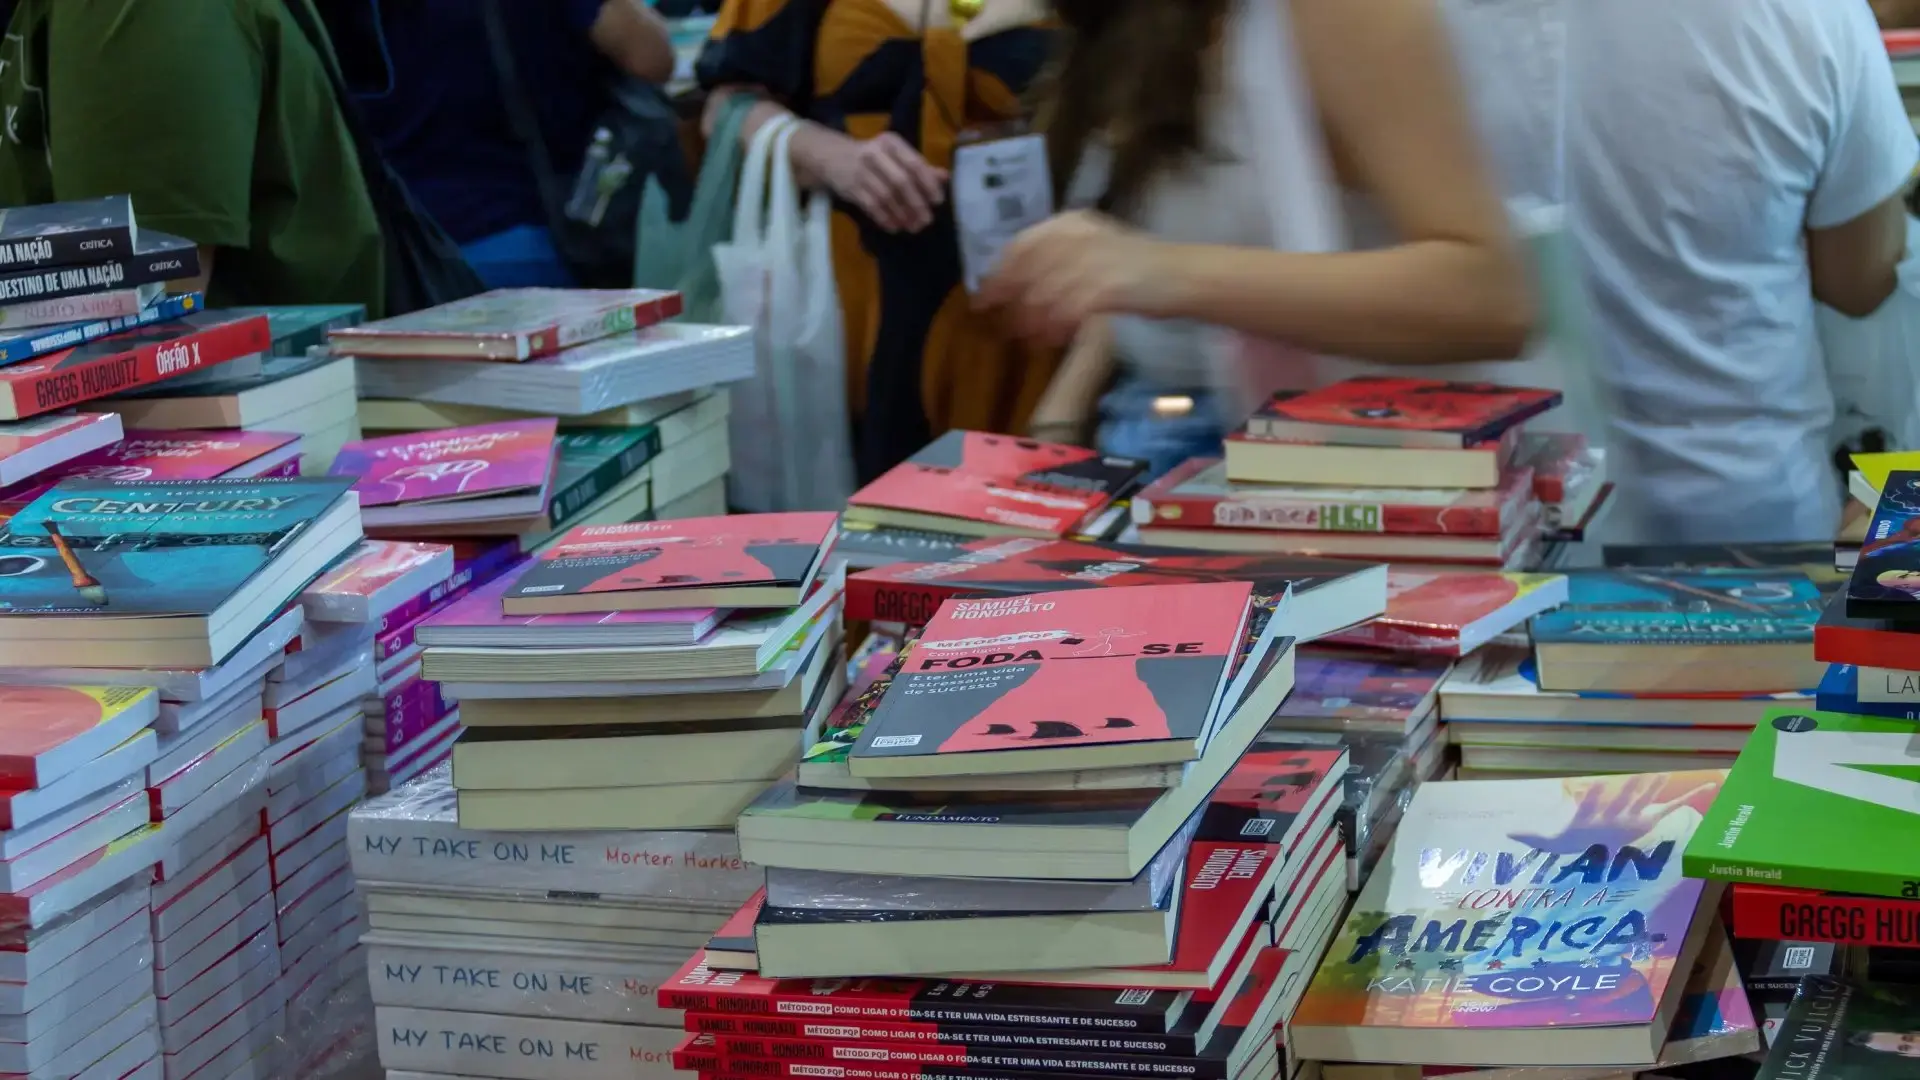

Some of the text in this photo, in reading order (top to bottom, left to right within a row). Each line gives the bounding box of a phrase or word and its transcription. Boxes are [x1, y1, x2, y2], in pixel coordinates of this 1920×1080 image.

[15, 236, 52, 264] NAÇÃO
[80, 238, 113, 250] CRÍTICA
[149, 259, 182, 272] CRÍTICA
[0, 260, 123, 298] DESTINO DE UMA NAÇÃO
[36, 341, 201, 408] GREGG HURWITZ ÓRFÃO X
[51, 495, 302, 514] CENTURY
[950, 602, 1056, 620] HONORATO
[955, 598, 1032, 611] SAMUEL
[1017, 631, 1053, 640] PQP
[920, 642, 1204, 670] FODA SE
[909, 675, 1001, 688] estressante
[926, 674, 948, 682] ter
[953, 671, 988, 680] uma
[993, 665, 1025, 674] vida
[905, 682, 998, 696] de SUCESSO
[895, 813, 1000, 823] FUNDAMENTO
[1718, 804, 1755, 849] Justin Herald
[365, 835, 576, 865] MY TAKE ON ME
[606, 847, 748, 872] Morten Harke
[1190, 849, 1240, 890] HONORATO
[1224, 849, 1268, 881] SAMUEL
[1418, 840, 1676, 888] VIVIAN
[1709, 863, 1782, 880] Justin Herald
[1458, 885, 1609, 909] CONTRA A
[1780, 903, 1865, 940] GREGG
[1347, 909, 1667, 964] AMÉRICA
[386, 964, 593, 994] MY TAKE ON ME
[624, 979, 660, 997] Mor
[1366, 974, 1620, 992] KATIE COYLE
[779, 1001, 813, 1012] MÉTODO
[815, 1005, 831, 1014] PQP
[834, 1006, 860, 1014] COMO
[862, 1007, 888, 1016] LIGAR
[899, 1009, 935, 1018] FODA-SE
[945, 1011, 961, 1019] TER
[963, 1012, 983, 1020] UMA
[985, 1013, 1005, 1021] VIDA
[1008, 1014, 1071, 1025] ESTRESSANTE
[1094, 1019, 1137, 1027] SUCESSO
[392, 1028, 600, 1061] MY TAKE ON ME
[807, 1025, 841, 1035] MÉTODO
[842, 1028, 859, 1037] PQP
[861, 1029, 888, 1037] COMO
[890, 1030, 915, 1039] LIGAR
[927, 1032, 964, 1041] FODA-SE
[973, 1034, 990, 1042] TER
[992, 1035, 1012, 1043] UMA
[1014, 1036, 1034, 1044] VIDA
[1036, 1037, 1099, 1047] ESTRESSANTE
[1110, 1040, 1121, 1048] DE
[1124, 1041, 1166, 1050] SUCESSO
[629, 1046, 674, 1065] Mort
[836, 1048, 869, 1058] MÉTODO
[871, 1051, 887, 1060] PQP
[890, 1052, 917, 1060] COMO
[919, 1053, 945, 1061] LIGAR
[955, 1055, 993, 1064] FODA-SE
[1002, 1057, 1018, 1065] TER
[1021, 1058, 1040, 1066] UMA
[1042, 1059, 1063, 1067] VIDA
[1065, 1060, 1128, 1070] ESTRESSANTE
[1139, 1063, 1150, 1071] DE
[1153, 1064, 1195, 1073] SUCESSO
[792, 1065, 825, 1075] MÉTODO
[827, 1068, 843, 1077] PQP
[846, 1069, 872, 1077] COMO
[874, 1070, 899, 1079] LIGAR
